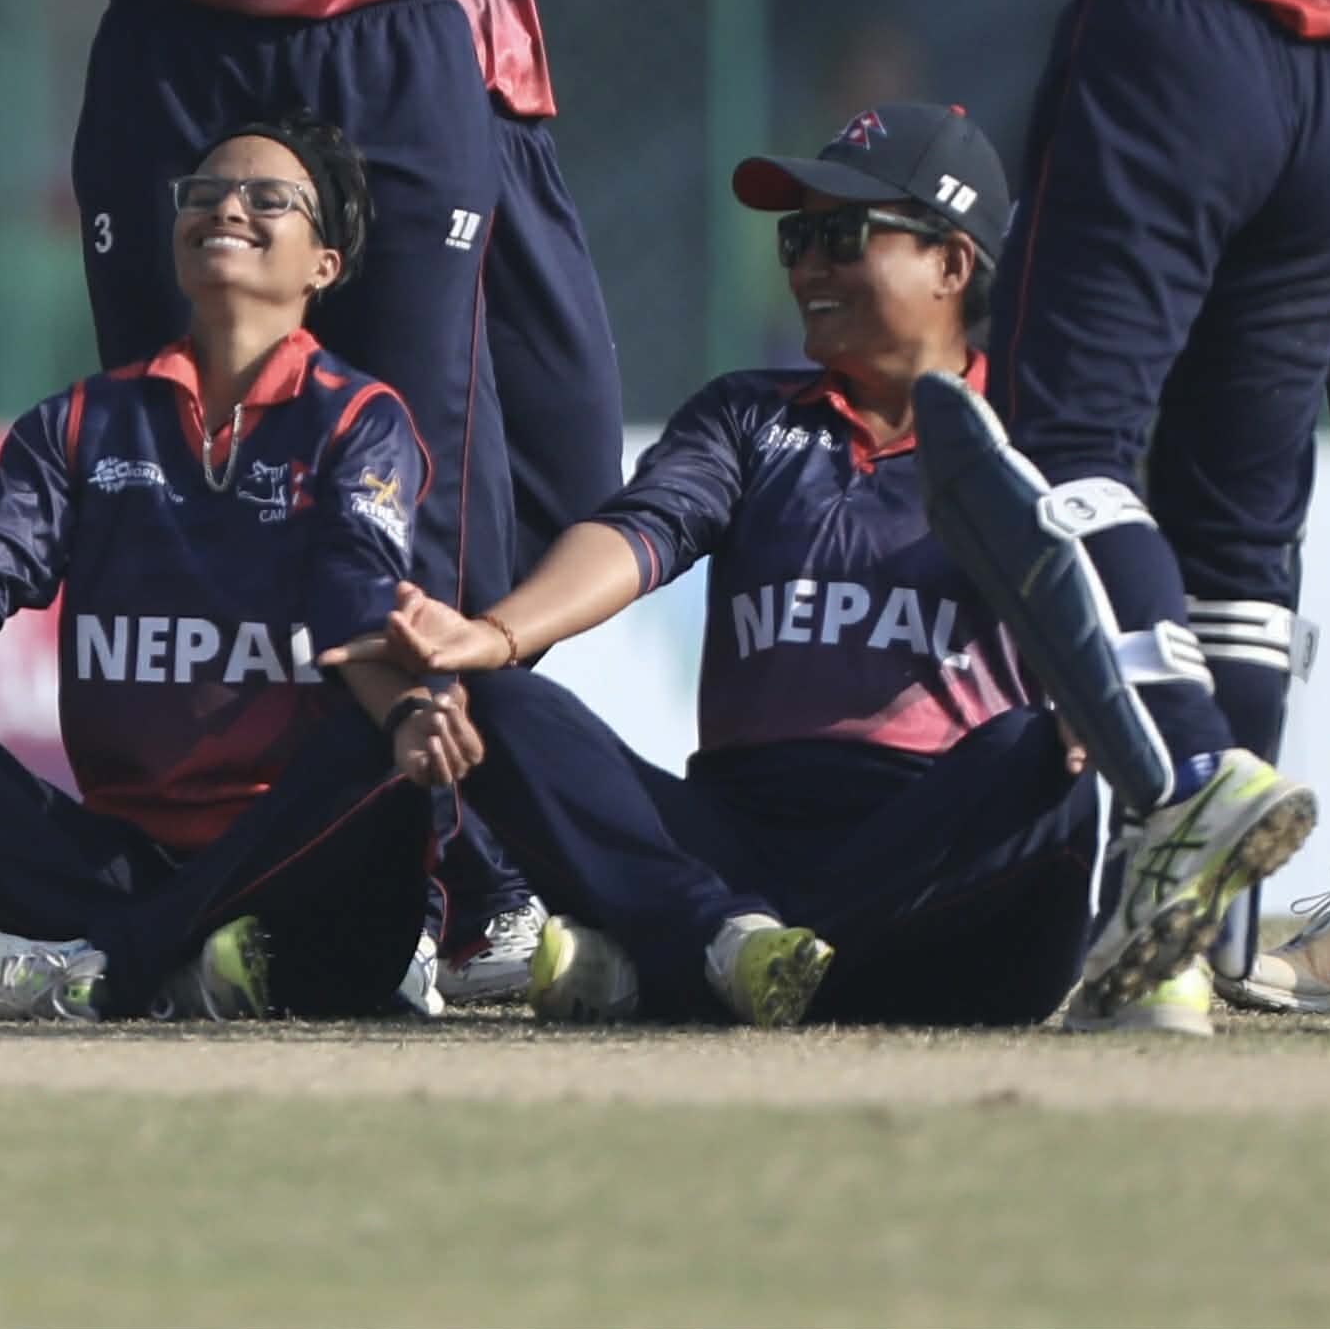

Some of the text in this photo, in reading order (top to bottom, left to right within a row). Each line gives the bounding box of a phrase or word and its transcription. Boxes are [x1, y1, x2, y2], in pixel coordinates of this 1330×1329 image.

[94, 213, 113, 253] 3
[76, 614, 323, 683] NEPAL
[732, 579, 971, 670] NEPAL
